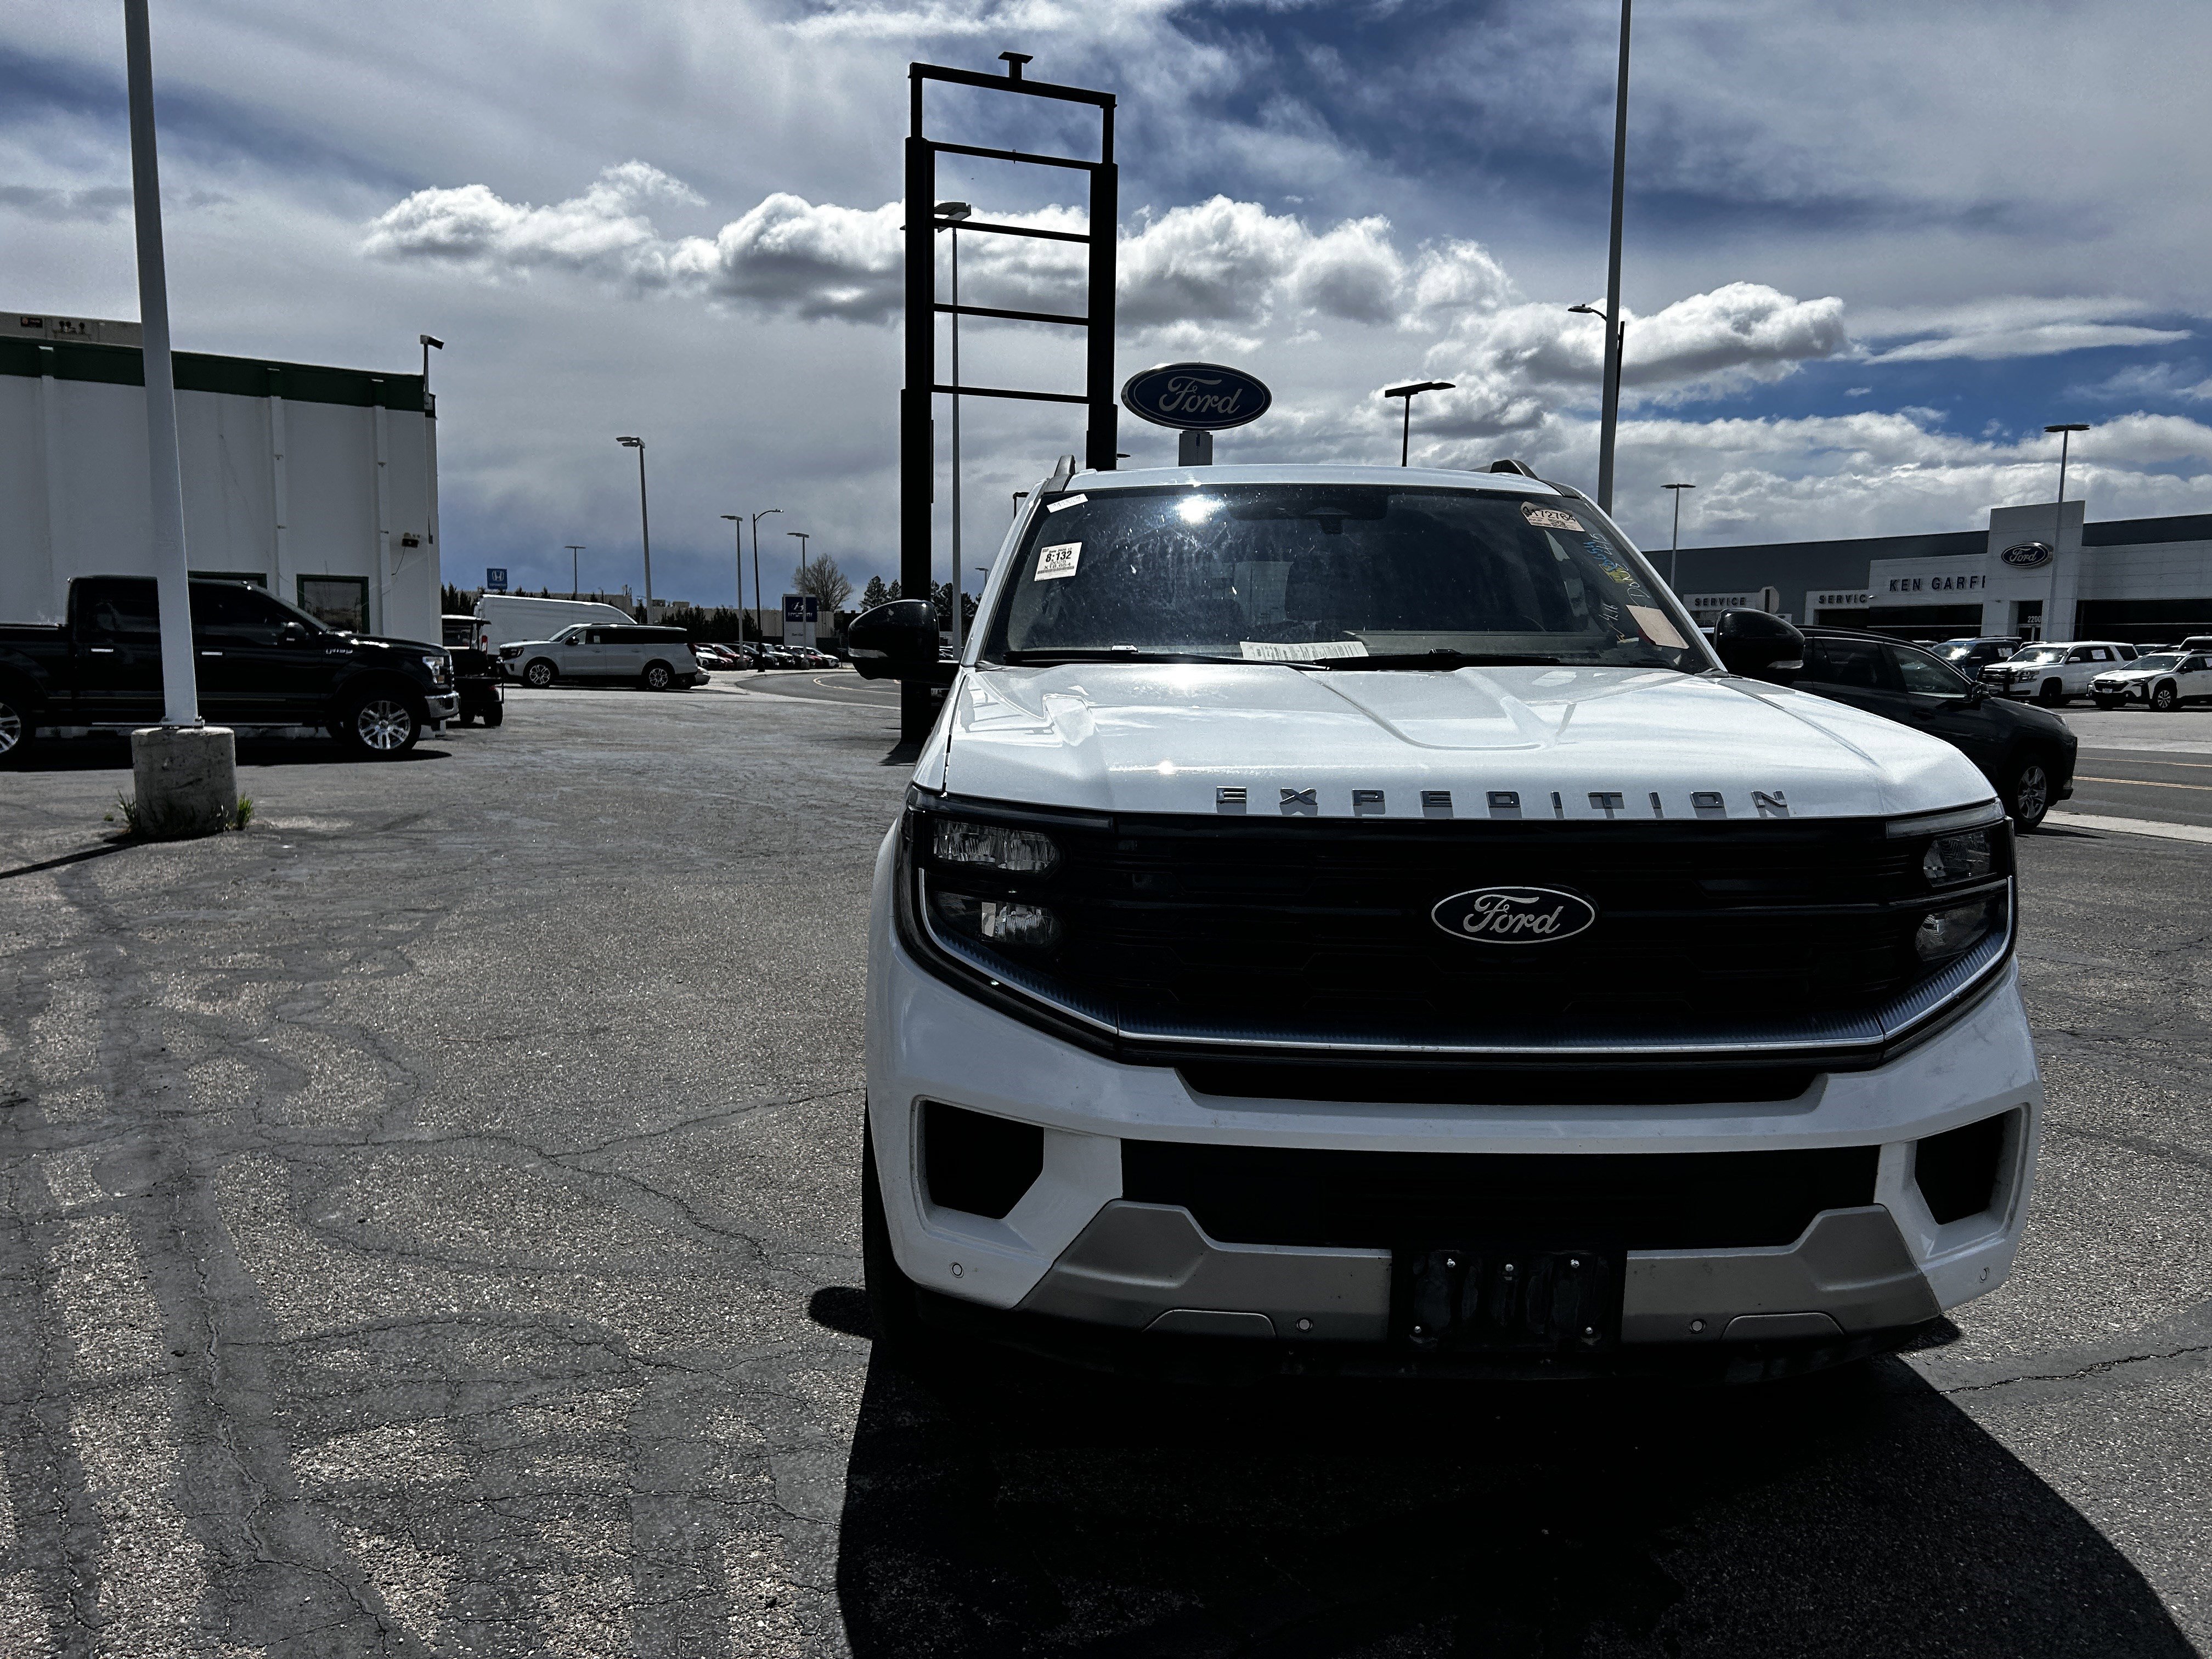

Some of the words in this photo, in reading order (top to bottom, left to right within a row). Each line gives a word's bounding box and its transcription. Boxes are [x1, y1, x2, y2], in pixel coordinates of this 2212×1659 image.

[1159, 376, 1243, 414] Ford
[2009, 548, 2039, 562] Ford
[1889, 578, 1922, 592] KEN
[1694, 597, 1746, 606] SERVICE
[1216, 786, 1788, 809] EXPEDITION
[1463, 894, 1564, 934] Ford
